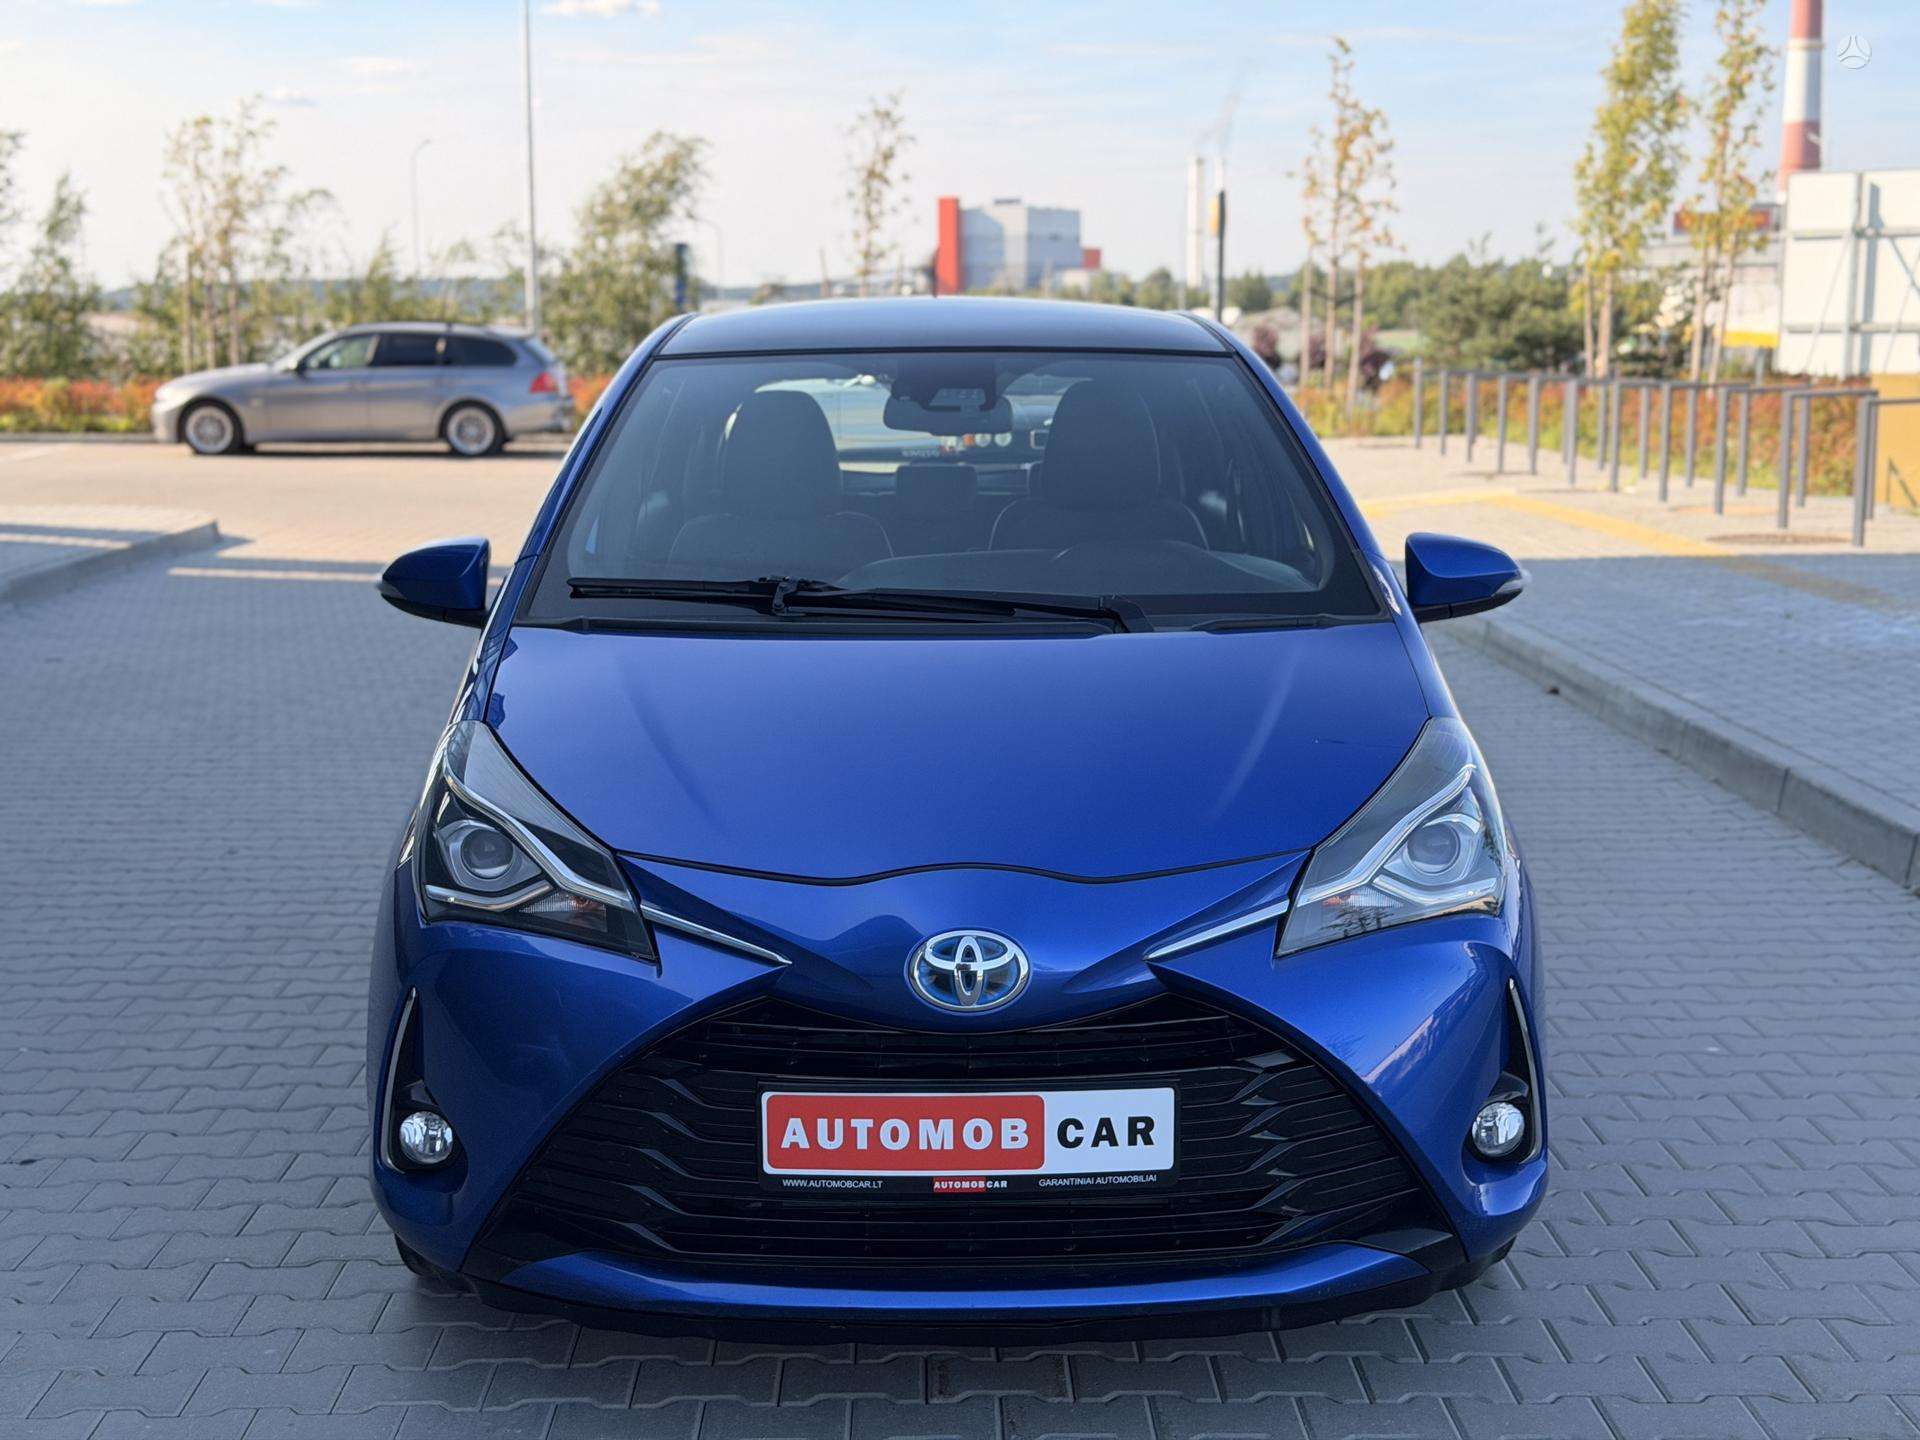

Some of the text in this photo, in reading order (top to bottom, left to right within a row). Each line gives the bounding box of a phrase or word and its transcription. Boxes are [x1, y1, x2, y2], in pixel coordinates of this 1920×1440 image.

[780, 1115, 1156, 1150] AUTOMOB CAR
[782, 1178, 883, 1189] WWW.AUTOMOBCAR.LT
[1038, 1174, 1157, 1187] GARANTINIAI AUTOMOBILIAI
